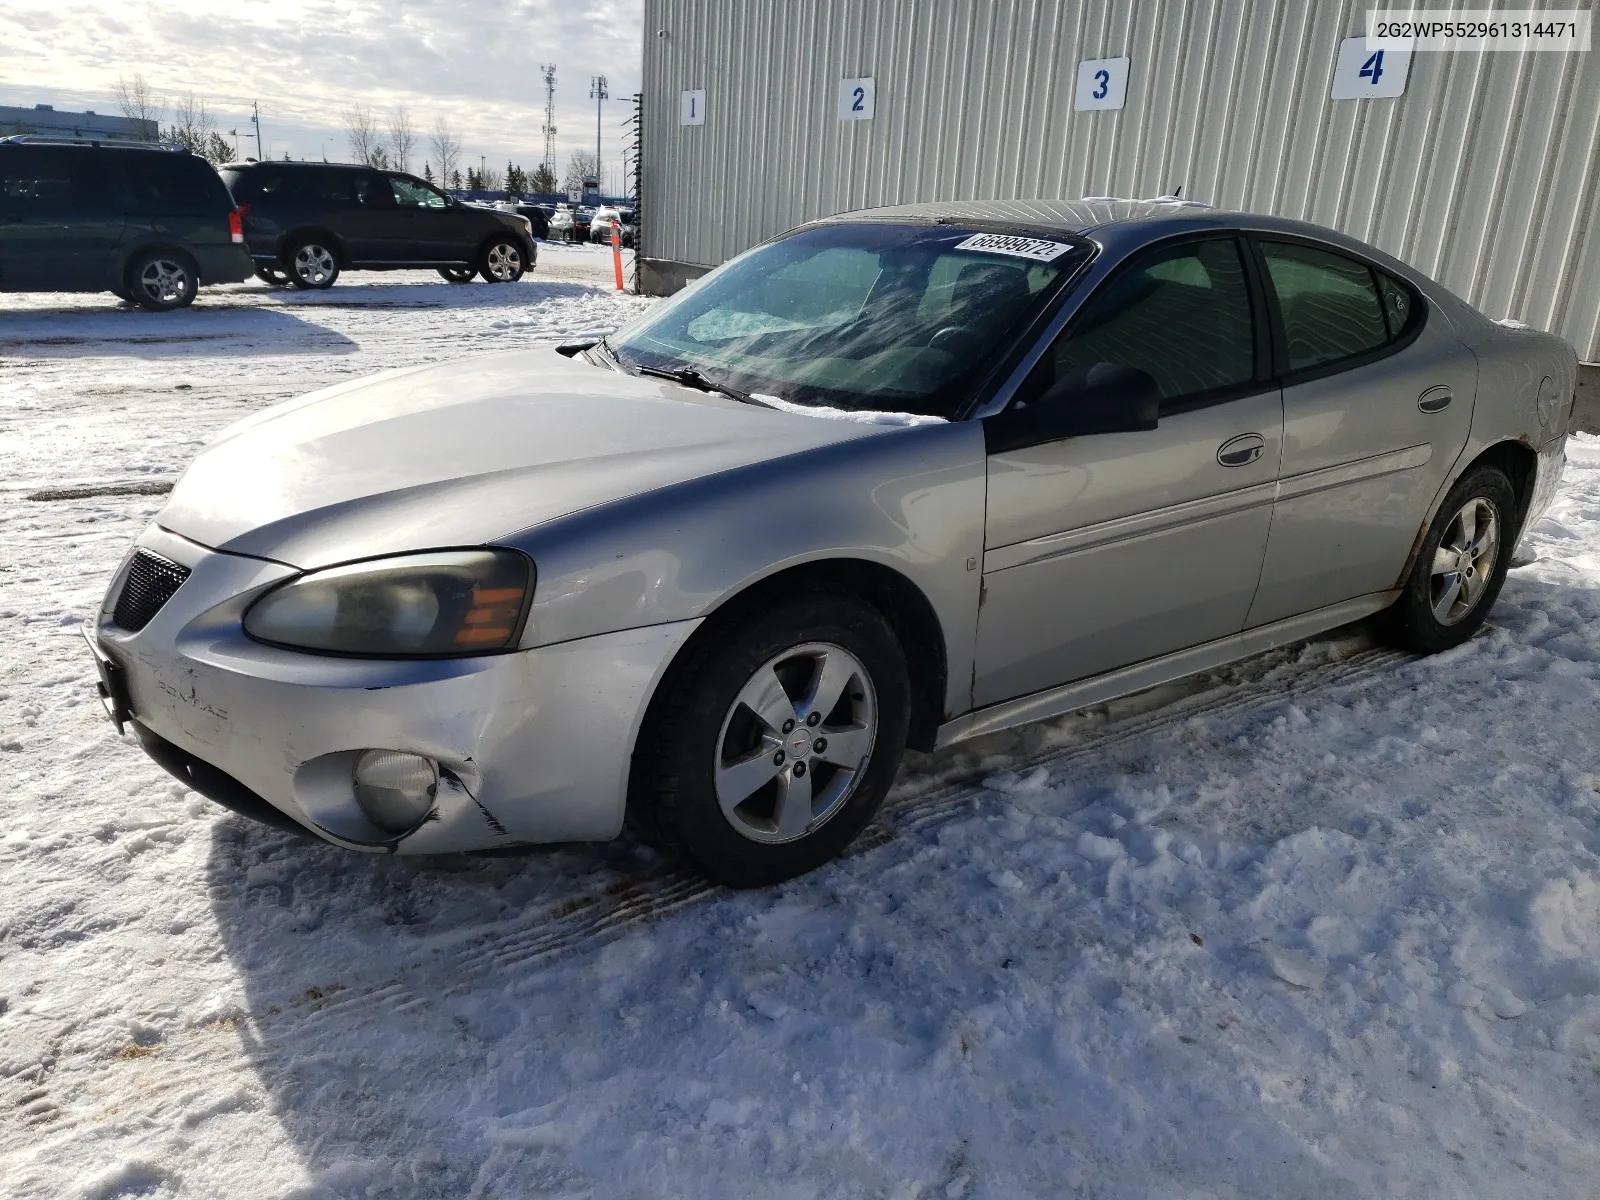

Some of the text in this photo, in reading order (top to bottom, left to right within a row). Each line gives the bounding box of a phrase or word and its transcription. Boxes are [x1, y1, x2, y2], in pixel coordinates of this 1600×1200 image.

[1358, 48, 1385, 84] 4
[1092, 69, 1110, 99] 3
[690, 97, 696, 118] 1
[852, 87, 865, 111] 2
[573, 192, 578, 200] 5
